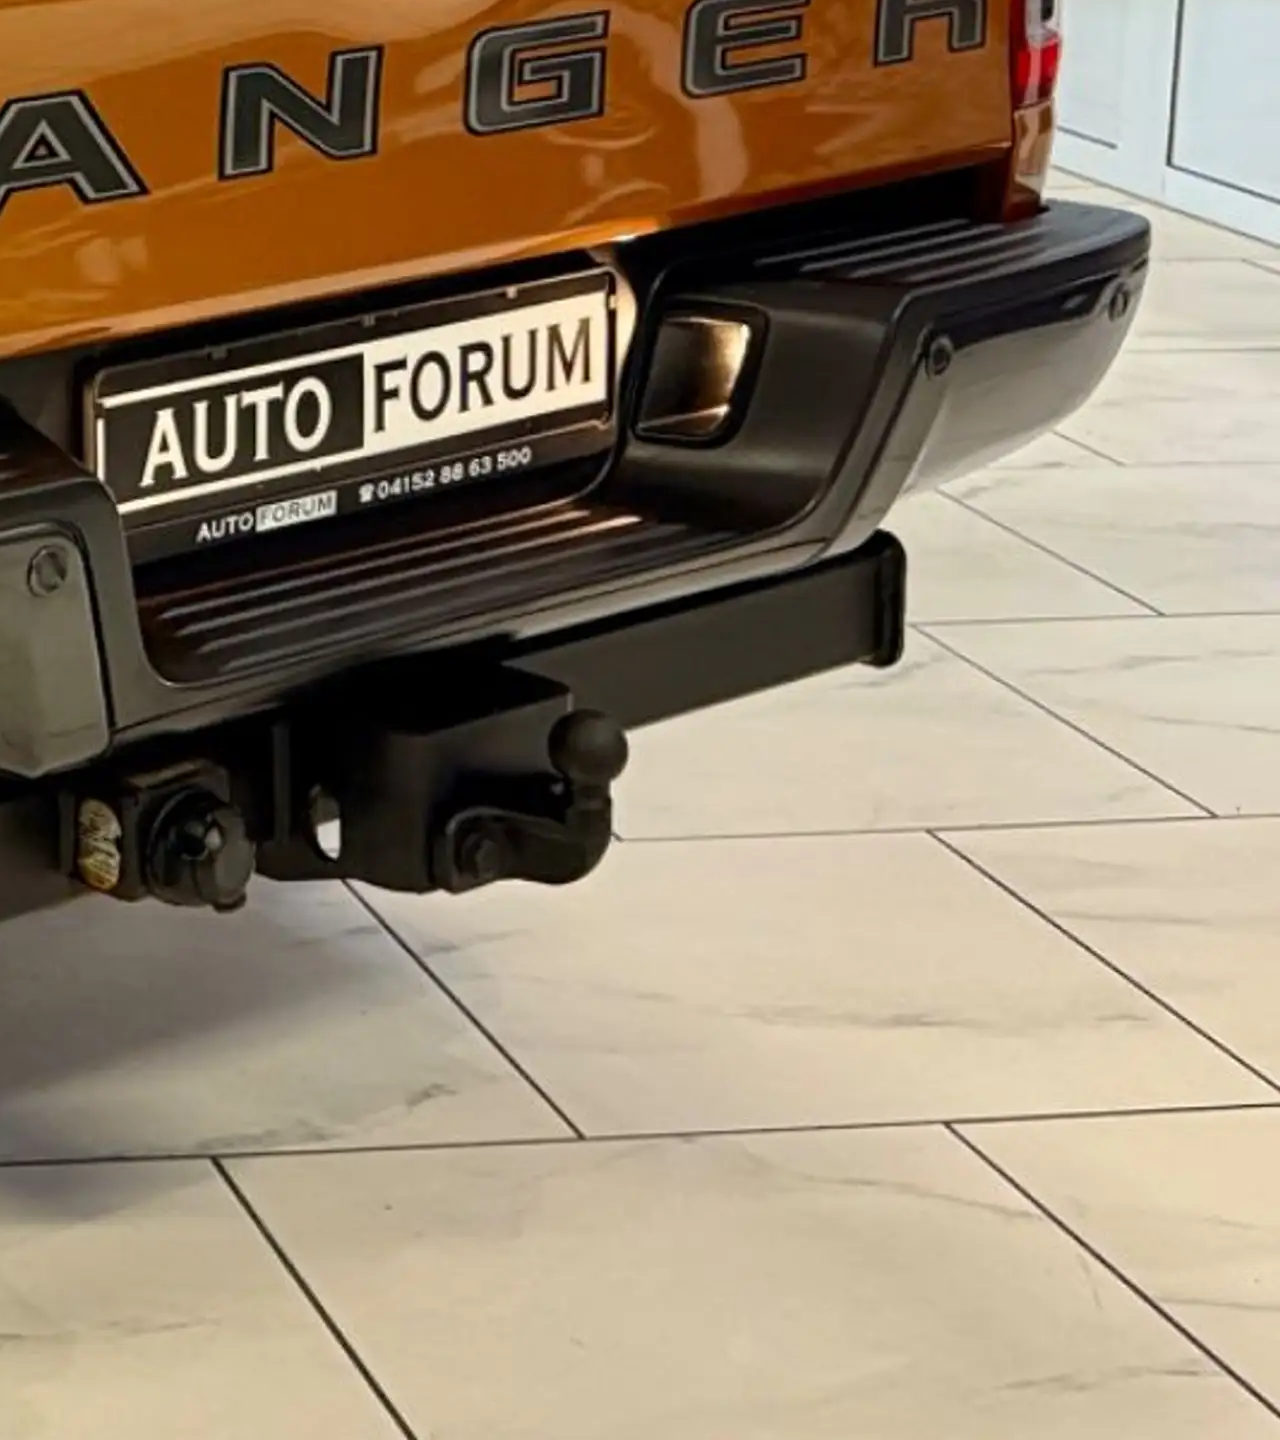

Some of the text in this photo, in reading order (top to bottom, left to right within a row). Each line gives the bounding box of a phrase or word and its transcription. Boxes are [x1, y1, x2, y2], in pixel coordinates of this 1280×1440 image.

[139, 316, 593, 489] AUTO FORUM
[376, 468, 437, 500] 04152
[468, 455, 492, 479] 63
[496, 446, 533, 472] 500
